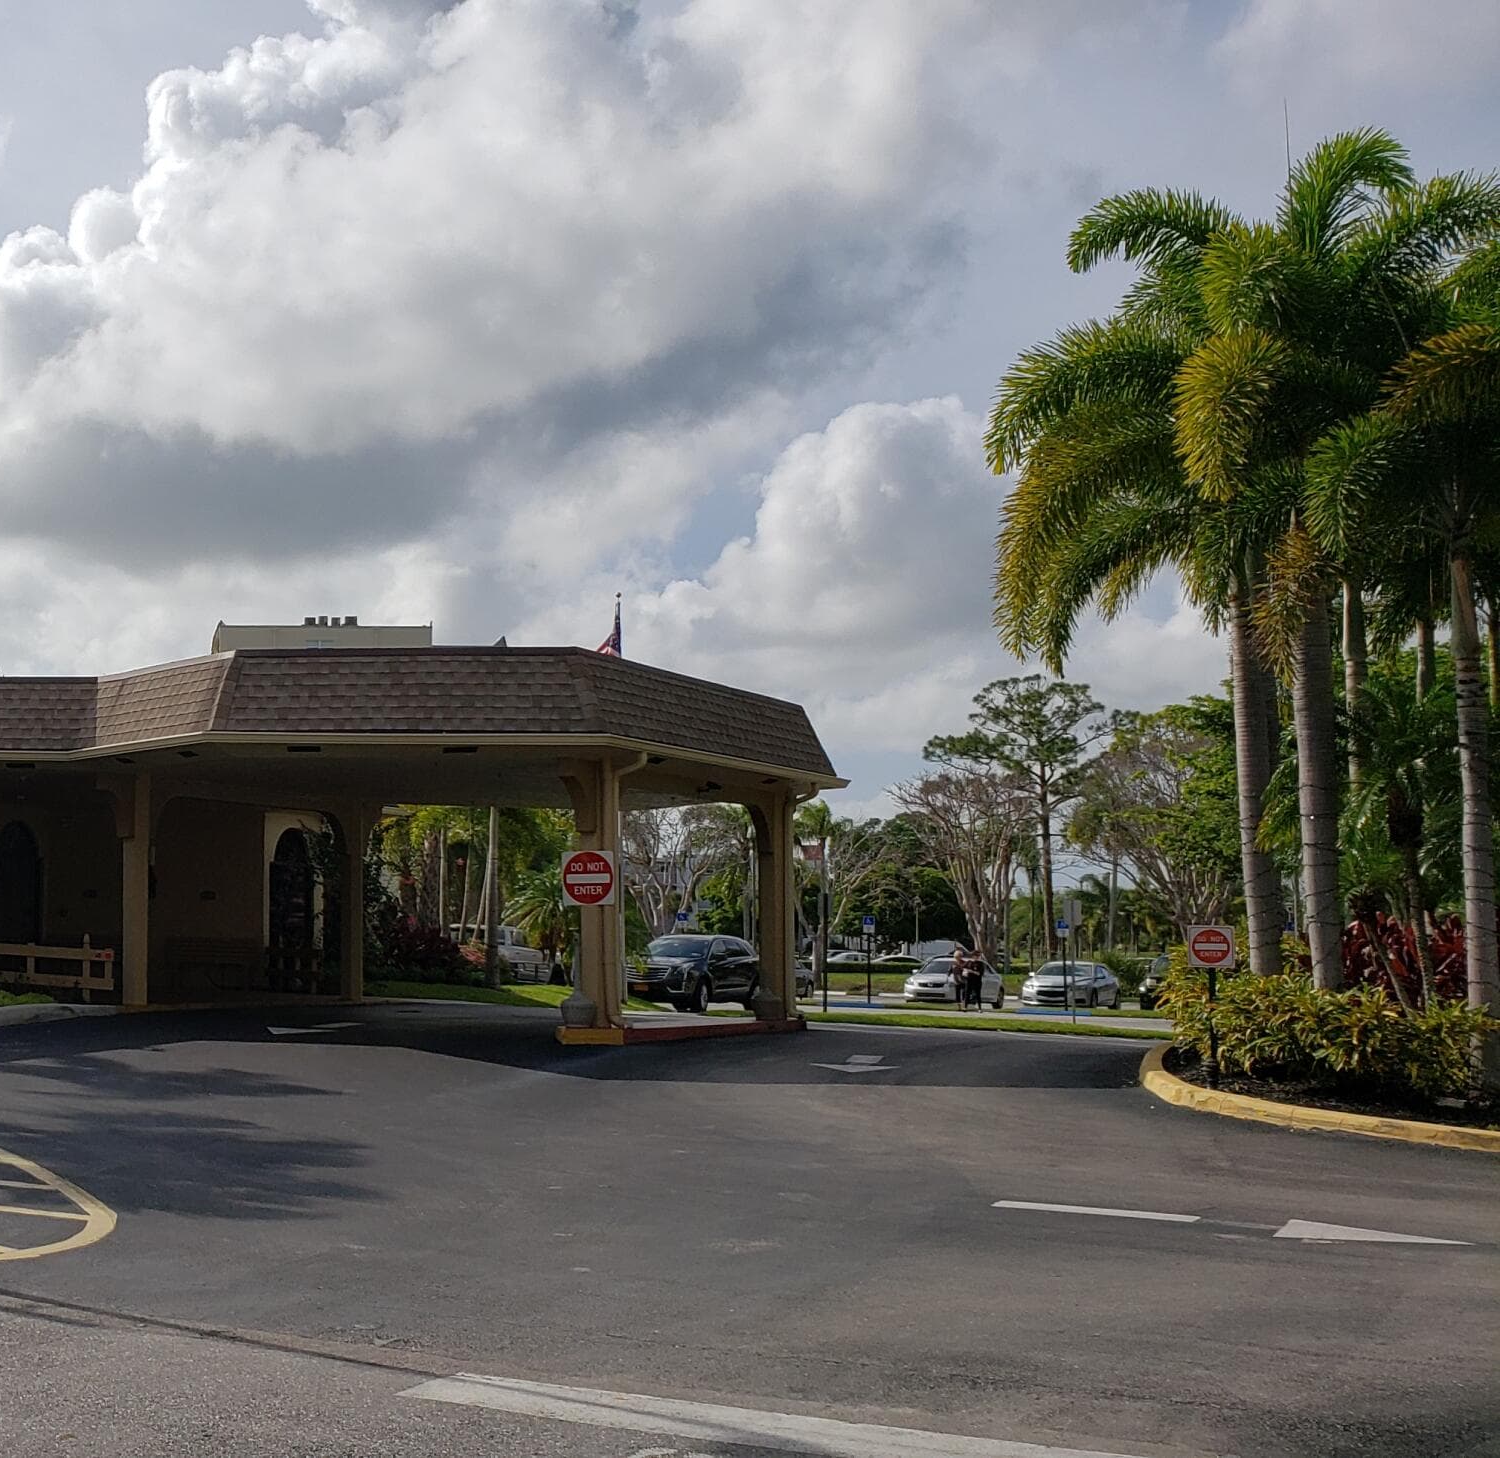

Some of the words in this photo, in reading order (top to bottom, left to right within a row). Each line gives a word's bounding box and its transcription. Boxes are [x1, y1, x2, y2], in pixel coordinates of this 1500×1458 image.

[571, 862, 583, 872] DO
[587, 862, 604, 872] NOT
[574, 885, 603, 895] ENTER
